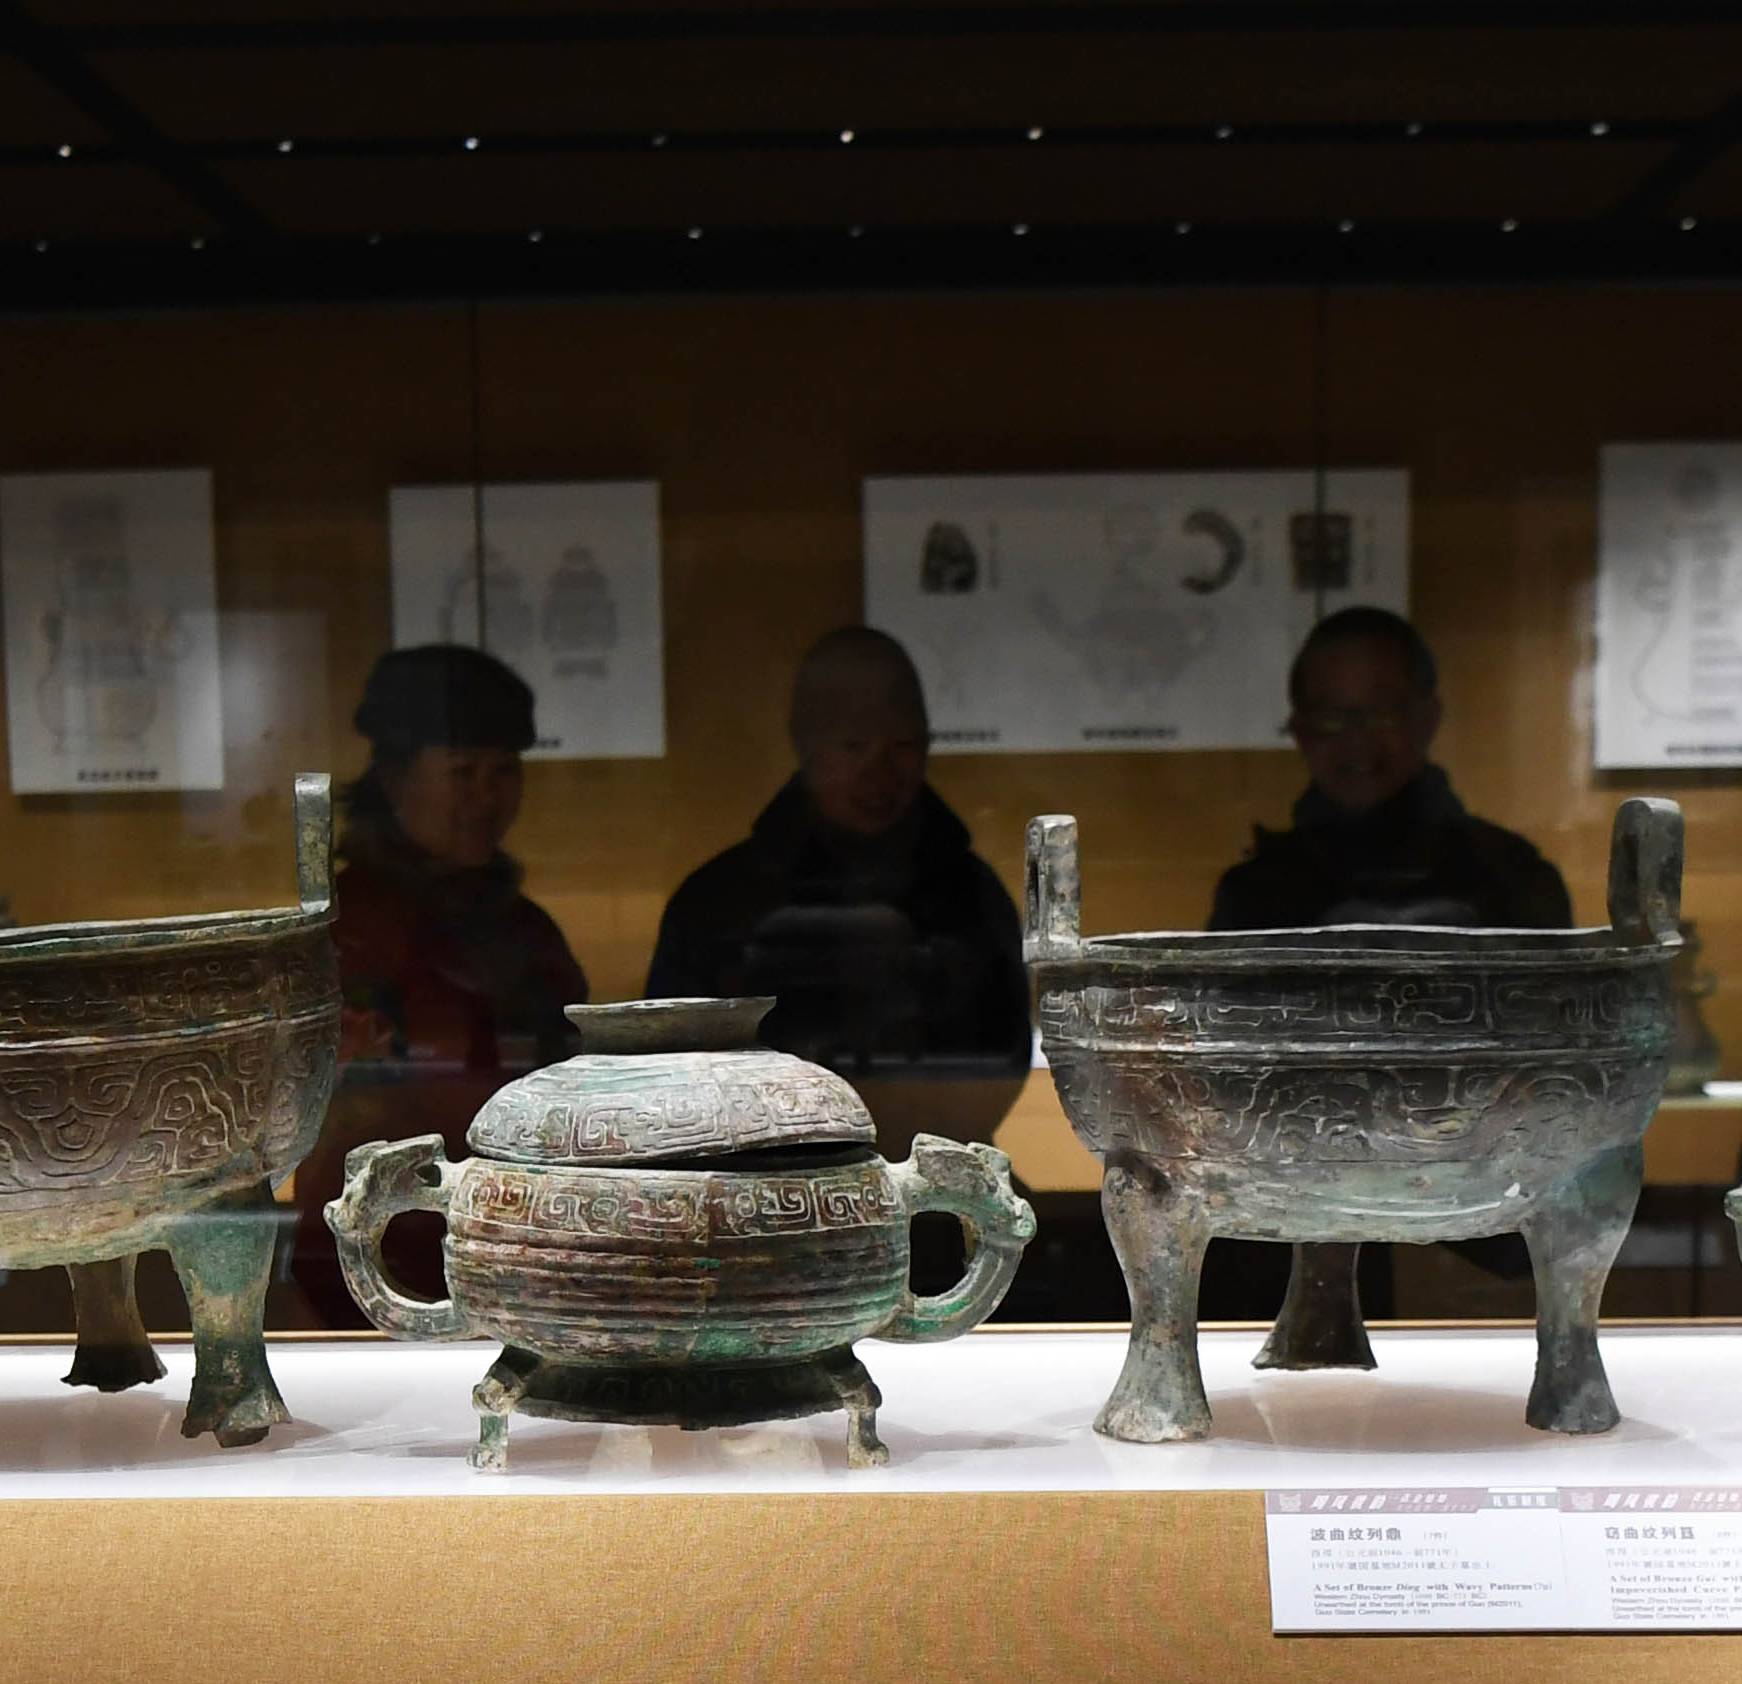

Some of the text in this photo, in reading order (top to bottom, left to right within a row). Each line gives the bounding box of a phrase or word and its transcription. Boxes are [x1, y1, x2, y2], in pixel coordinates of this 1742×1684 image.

[1621, 1575, 1637, 1583] Set
[1640, 1575, 1651, 1583] of
[1654, 1575, 1693, 1583] Bronze
[1315, 1583, 1321, 1592] A
[1325, 1583, 1340, 1592] Set
[1343, 1583, 1353, 1592] of
[1357, 1583, 1392, 1592] Bronze
[1395, 1583, 1420, 1592] Ding
[1427, 1583, 1448, 1592] with
[1454, 1583, 1482, 1592] Wavy
